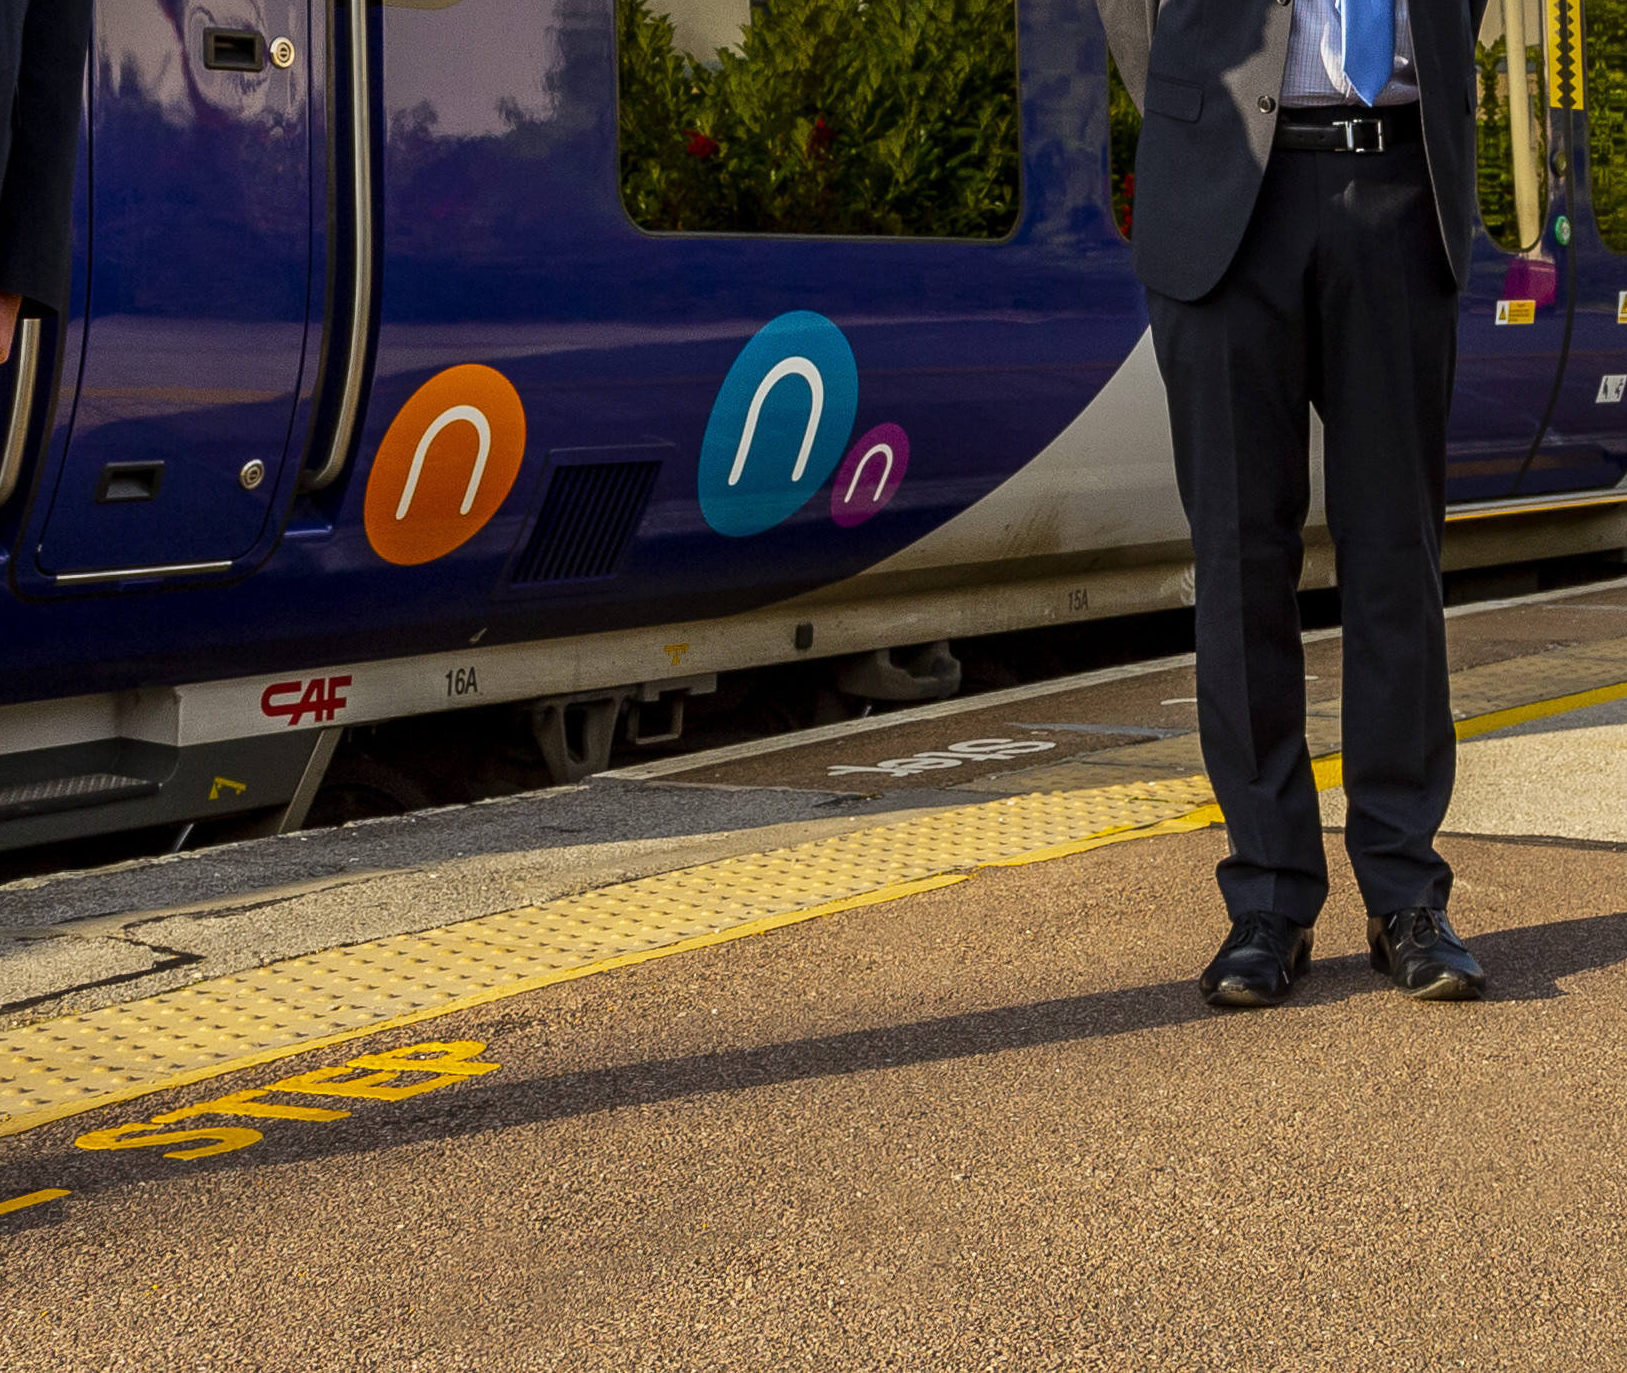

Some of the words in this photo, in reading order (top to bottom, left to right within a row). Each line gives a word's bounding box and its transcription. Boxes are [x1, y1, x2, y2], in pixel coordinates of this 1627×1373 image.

[260, 675, 352, 726] CAF
[445, 666, 478, 697] 16A
[74, 1039, 501, 1161] STEP
